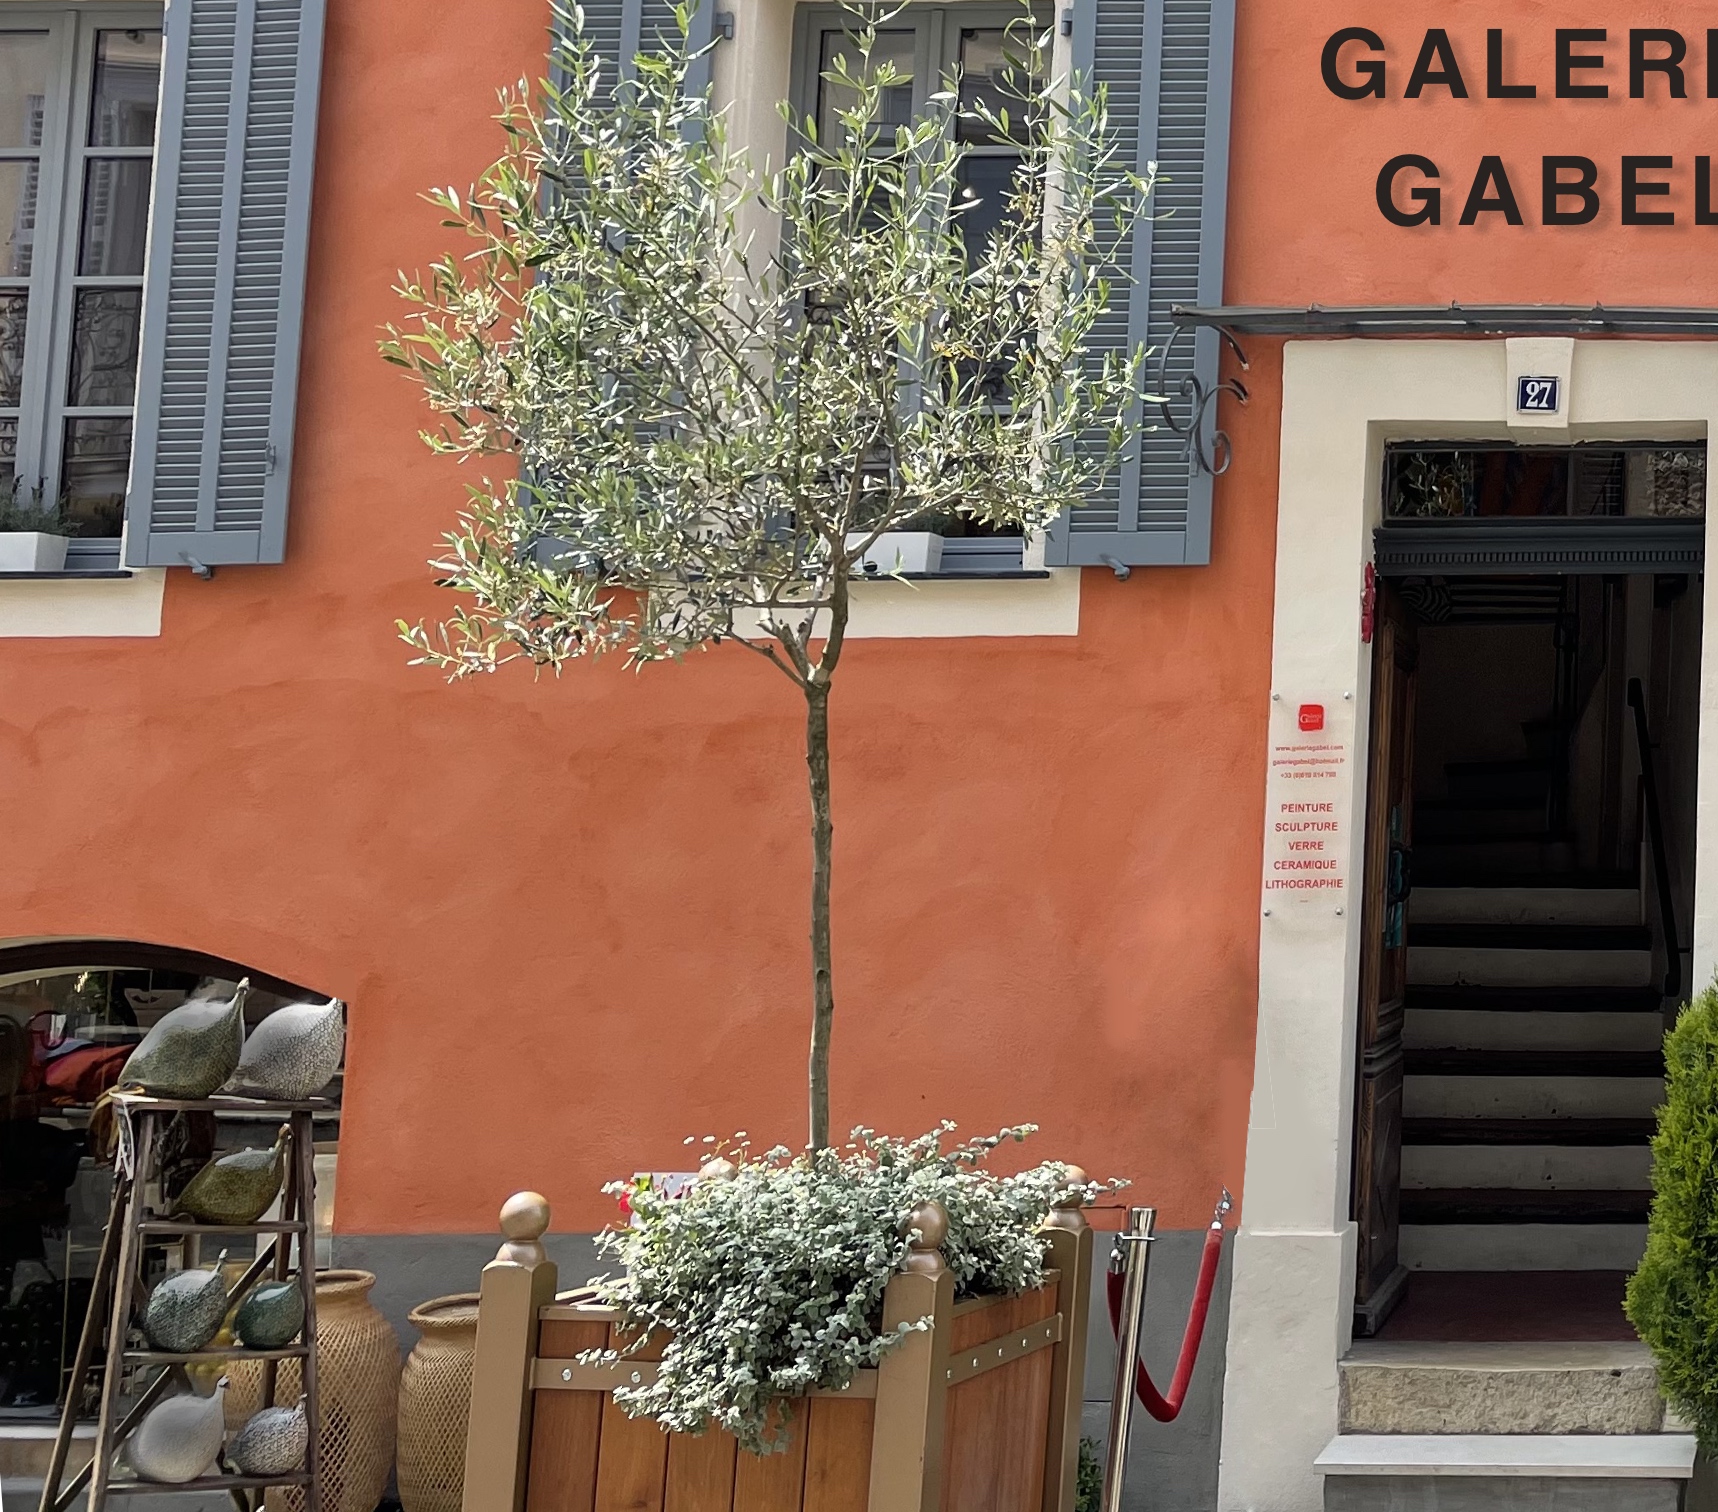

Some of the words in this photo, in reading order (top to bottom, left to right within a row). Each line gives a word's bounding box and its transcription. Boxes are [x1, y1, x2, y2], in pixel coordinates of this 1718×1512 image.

[1525, 381, 1552, 408] 27
[1281, 803, 1333, 813] PEINTURE
[1275, 822, 1338, 832] SCULPTURE
[1288, 841, 1324, 851] VERRE
[1273, 860, 1337, 870] CERAMIQUE
[1265, 879, 1344, 889] LITHOGRAPHIE
